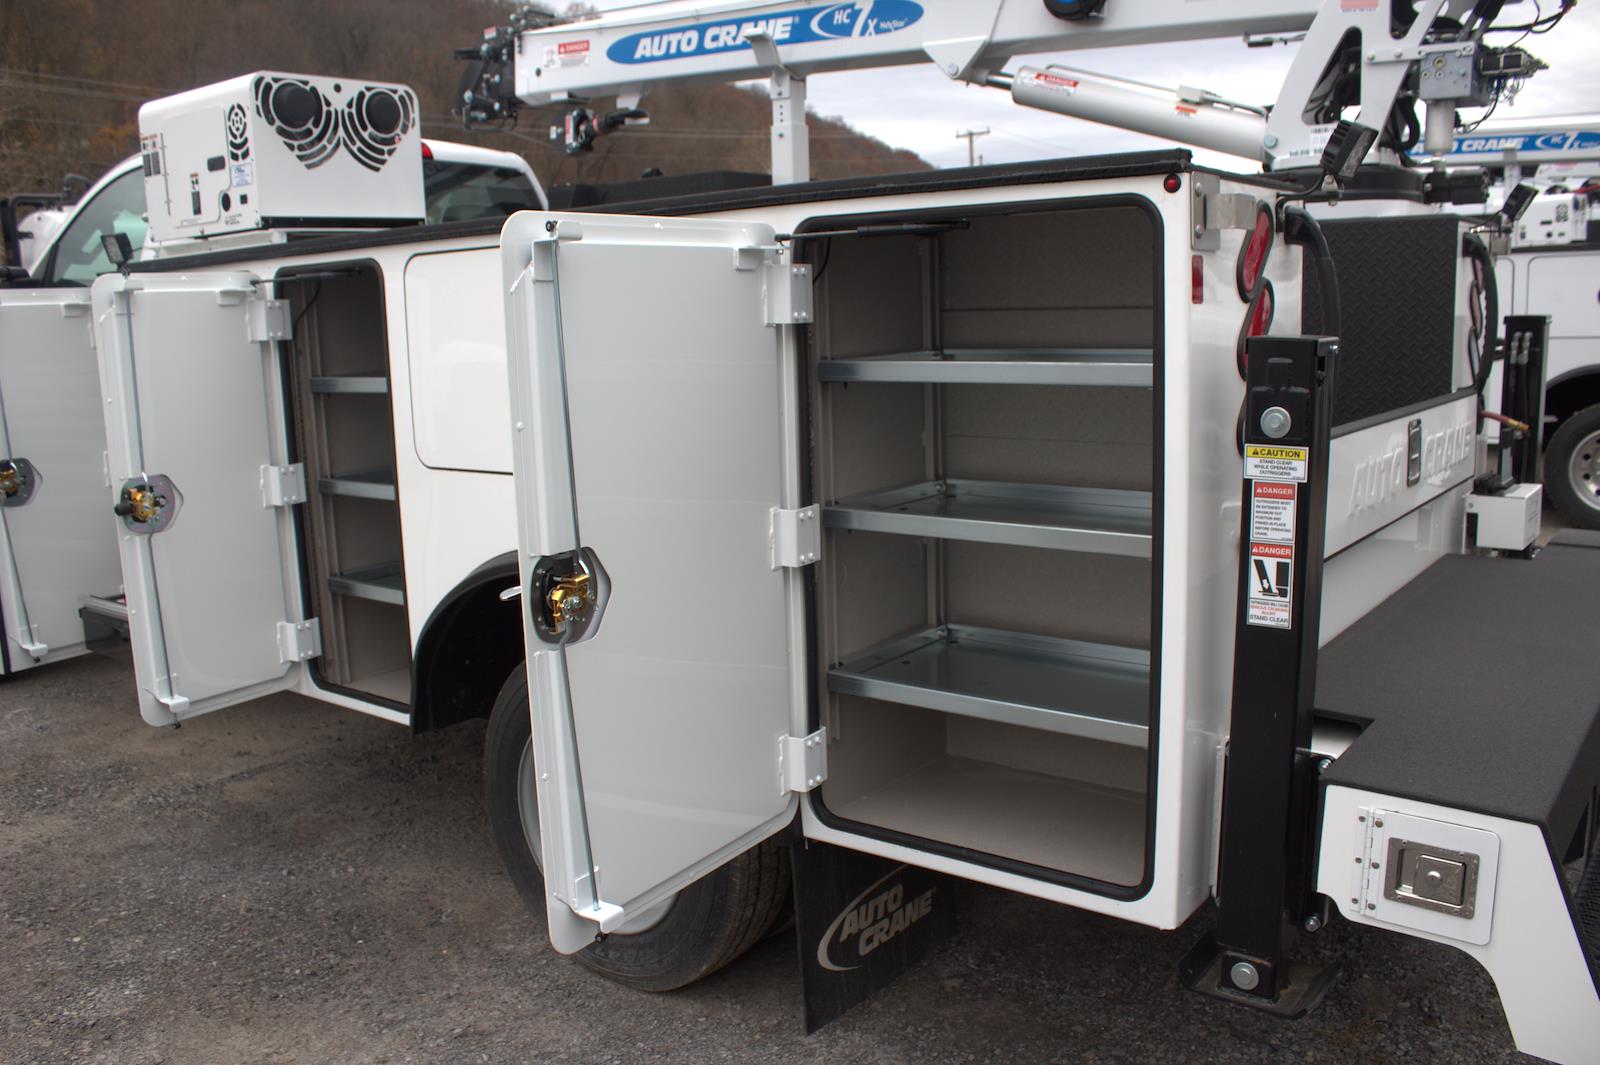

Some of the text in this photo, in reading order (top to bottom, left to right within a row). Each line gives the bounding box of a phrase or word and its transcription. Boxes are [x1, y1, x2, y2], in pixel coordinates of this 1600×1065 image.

[833, 8, 852, 25] HC
[634, 16, 792, 59] AUTO CRANE
[1260, 448, 1300, 458] CAUTION
[1262, 486, 1293, 495] DANGER
[1259, 546, 1292, 556] DANGER
[839, 883, 933, 957] AUTO CRANE
